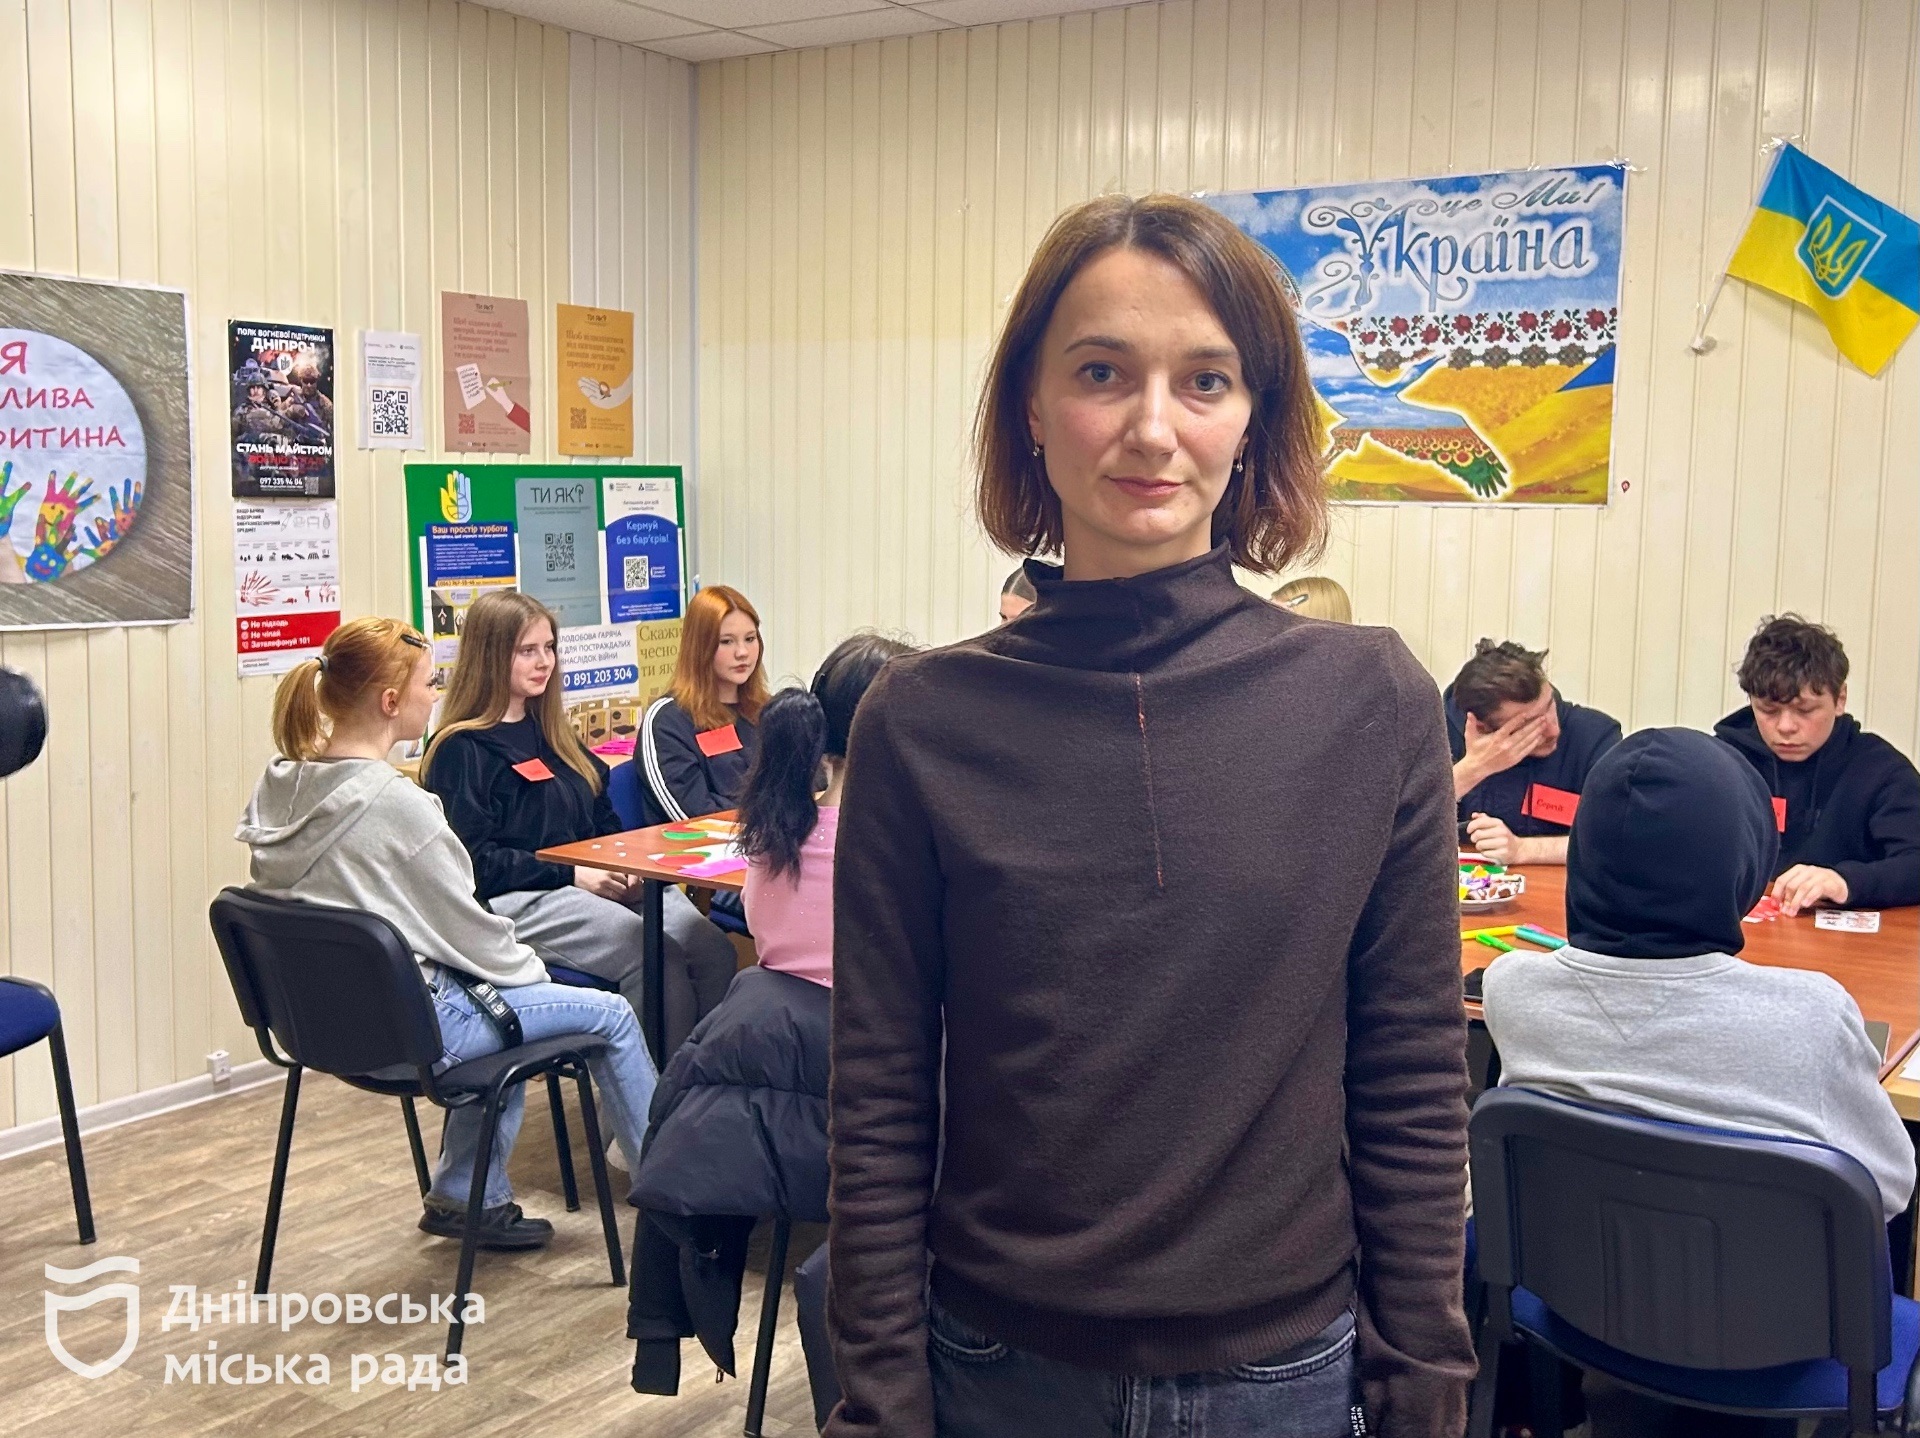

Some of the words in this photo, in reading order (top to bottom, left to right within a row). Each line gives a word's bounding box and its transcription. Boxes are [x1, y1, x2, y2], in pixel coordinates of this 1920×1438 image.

[1305, 197, 1589, 320] Україна
[237, 328, 256, 336] ПОЛК
[258, 329, 291, 339] ВОГНЕВОЇ
[251, 337, 315, 354] ДНІПРО-1
[0, 341, 27, 375] Я
[236, 443, 273, 454] СТАНЬ
[276, 442, 332, 456] МАЙСТРОМ
[530, 487, 551, 503] ТИ
[450, 525, 478, 535] простір
[480, 525, 508, 534] турботи
[626, 520, 659, 532] Кермуй
[616, 534, 631, 545] без
[250, 631, 260, 639] Не
[598, 629, 622, 639] ГАРЯЧА
[251, 638, 297, 648] Зателефонуй
[299, 636, 310, 644] 101
[565, 646, 577, 654] ДЛЯ
[579, 640, 631, 652] ПОСТРАЖДАЛИХ
[598, 652, 618, 662] ВІЙНИ
[640, 645, 677, 659] чесно
[573, 672, 592, 686] 891
[594, 669, 612, 683] 203
[614, 667, 633, 681] 304
[641, 665, 655, 677] ти
